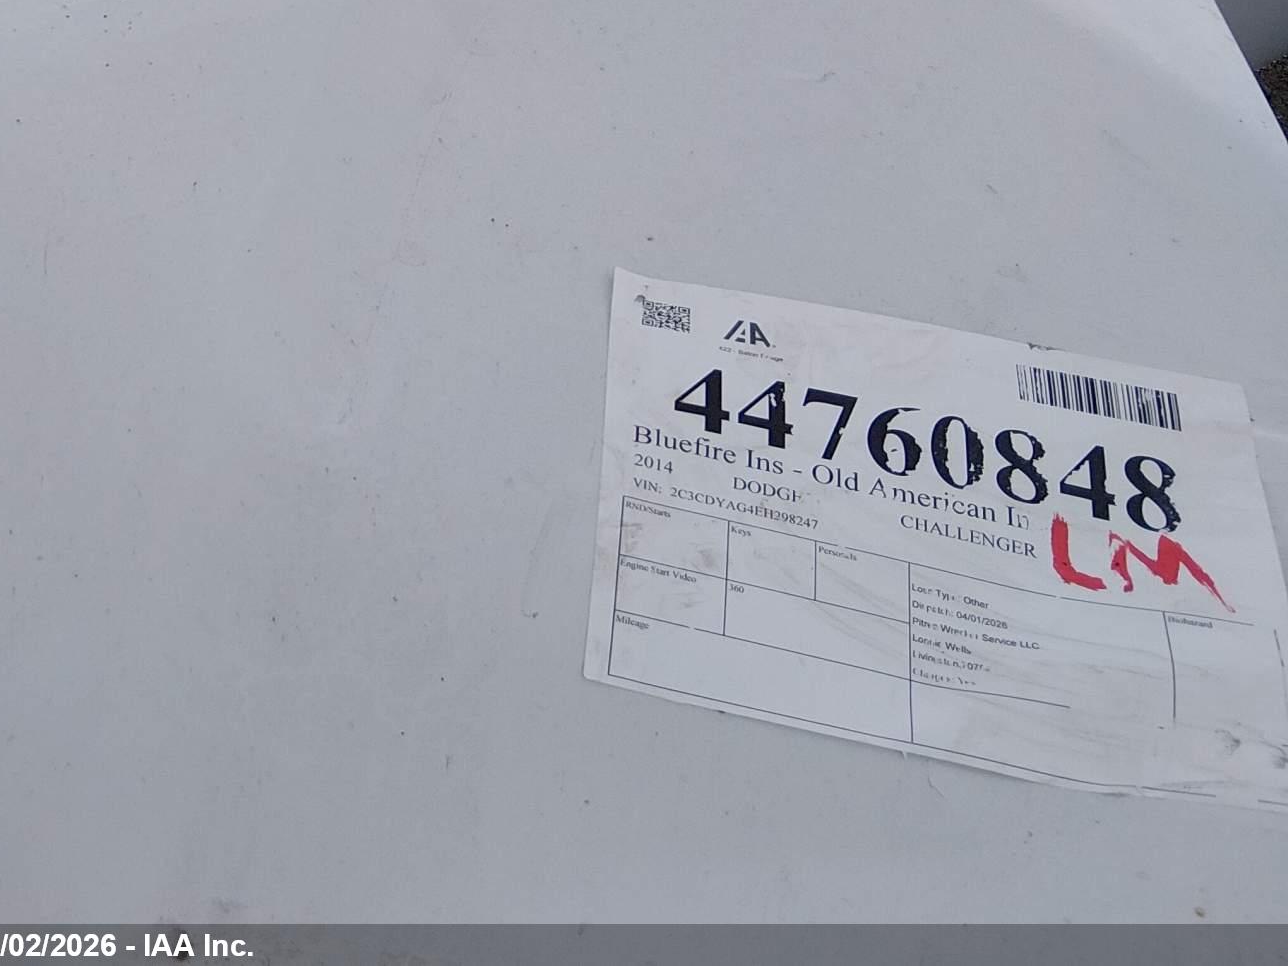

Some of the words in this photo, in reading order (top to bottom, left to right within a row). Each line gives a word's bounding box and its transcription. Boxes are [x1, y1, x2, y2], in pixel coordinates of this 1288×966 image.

[674, 368, 1182, 534] 44760848
[633, 424, 737, 464] Bluefire
[746, 449, 784, 475] Ins
[812, 464, 860, 492] Old
[869, 477, 997, 523] American
[633, 477, 662, 494] VIN:
[669, 486, 819, 530] 2C3CDYAG4EH298247
[633, 453, 674, 474] 2014
[900, 514, 1038, 559] CHALLENGER
[730, 525, 753, 538] Keys
[620, 557, 650, 574] Engine
[650, 565, 671, 578] Start
[672, 570, 698, 584] Video
[728, 584, 745, 594] 360
[963, 595, 990, 610] Other
[615, 614, 650, 630] Mileage
[981, 633, 1017, 648] Service
[1019, 640, 1040, 651] LLC
